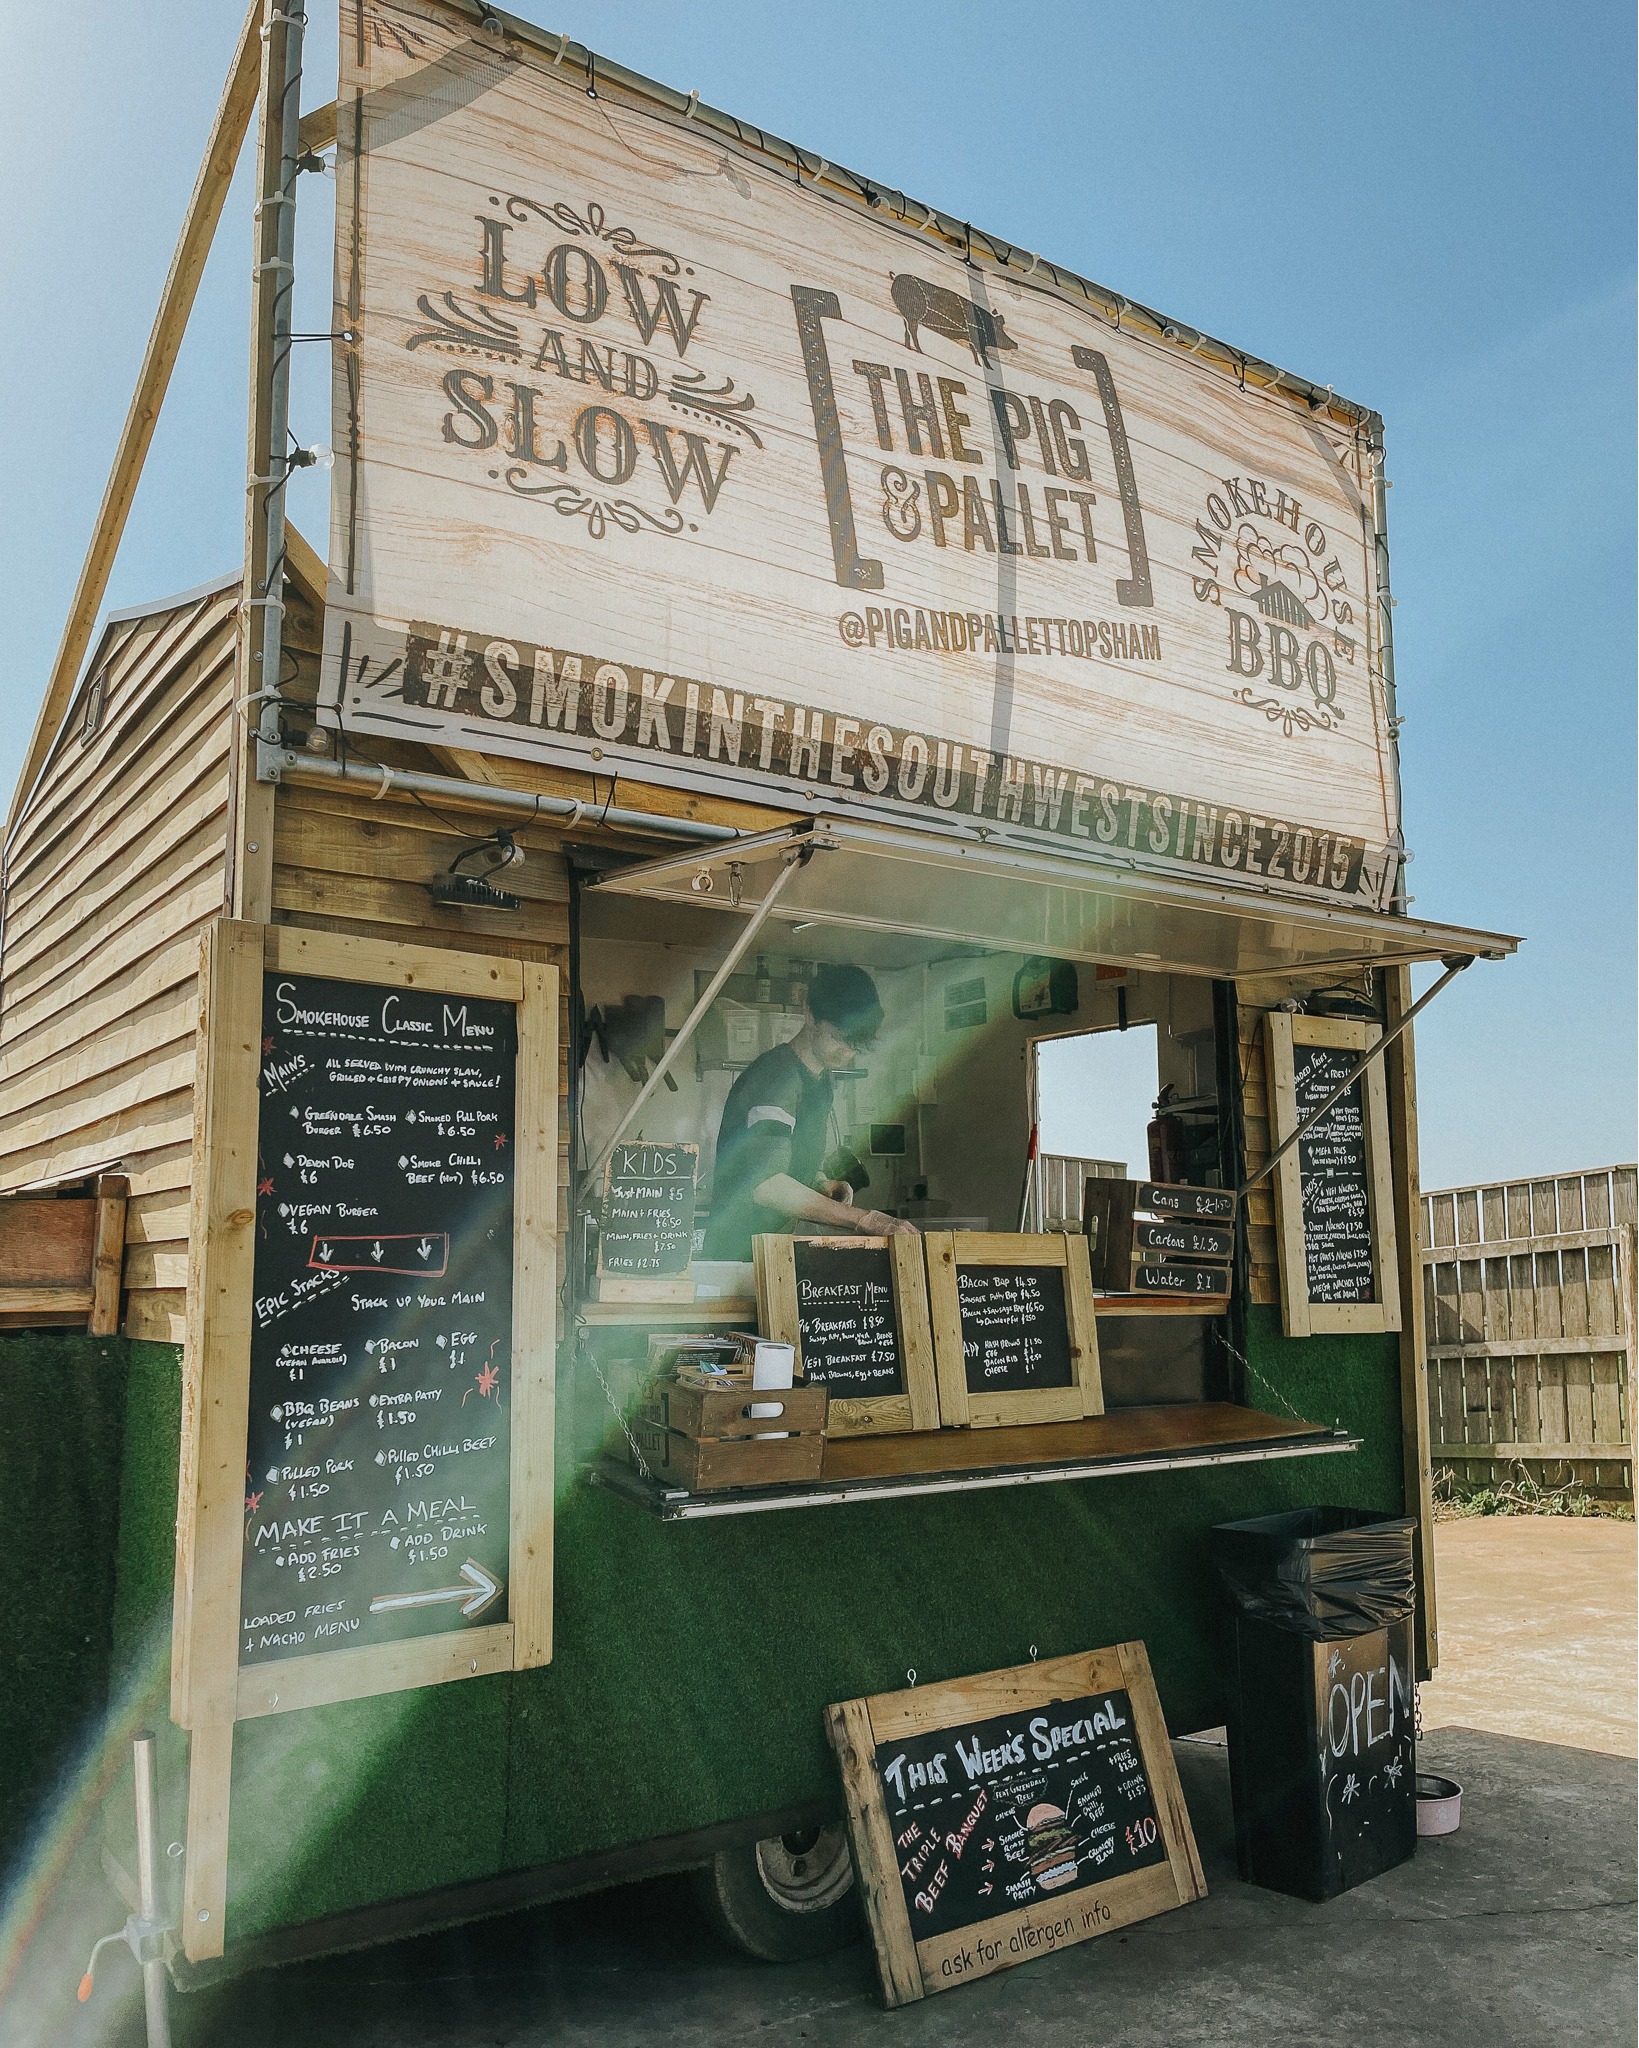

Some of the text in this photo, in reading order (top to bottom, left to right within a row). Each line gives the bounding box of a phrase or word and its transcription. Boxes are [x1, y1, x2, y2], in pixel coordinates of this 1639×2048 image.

[473, 215, 711, 358] LOW
[530, 328, 659, 401] AND
[852, 359, 1092, 481] THE PIG
[441, 369, 741, 515] SLOW
[1192, 477, 1355, 665] SMOKEHOUSE
[839, 606, 1162, 661] @PIGANDPALLETTOPSHAM
[1224, 607, 1345, 720] BBQ
[421, 631, 1352, 889] #SMOKINTHESOUTHWESTSINCE2015
[276, 982, 494, 1037] SMOKEHOUSE CLASSIC MENU
[263, 1054, 306, 1092] MAINS
[326, 1058, 482, 1078] ALL SERVED WITH CRUNCHY SLAW,
[329, 1071, 366, 1083] GRILLED
[376, 1073, 412, 1087] CRISPY
[412, 1077, 449, 1087] ONIONS
[304, 1105, 397, 1122] GREENDALE SMASH
[418, 1110, 498, 1123] SMOKED PULL PORK
[301, 1121, 342, 1135] BURGER
[297, 1154, 355, 1169] DEVON DOG
[410, 1154, 442, 1169] SMOKE
[622, 1150, 678, 1176] KIDS
[405, 1172, 436, 1184] BEEF
[288, 1203, 379, 1217] VEGAN BURGER
[1152, 1190, 1179, 1209] Cans
[611, 1208, 638, 1219] MAIN
[646, 1208, 671, 1218] FRIES
[660, 1231, 688, 1240] DRINK
[1148, 1228, 1185, 1249] Cartons
[608, 1257, 634, 1268] FRIES
[957, 1274, 989, 1288] BACON
[1145, 1268, 1186, 1287] Water
[351, 1291, 486, 1312] STACK UP YOUR MAIN
[796, 1279, 888, 1305] BREAKFAST MENU
[254, 1292, 289, 1319] EPIC
[291, 1343, 343, 1356] CHEESE
[379, 1338, 419, 1352] BACON
[451, 1332, 478, 1347] EGG
[282, 1397, 360, 1417] BBQ BEANS
[378, 1388, 443, 1407] EXTRA PATTY
[462, 1435, 498, 1452] BEEF
[280, 1458, 355, 1483] PULLED PORK
[254, 1495, 476, 1548] MAKE IT A MEAL
[404, 1523, 488, 1548] ADD DRINK
[287, 1545, 360, 1566] ADD FRIES
[244, 1600, 346, 1630] LOADED FRIES
[259, 1631, 306, 1649] NACHO
[314, 1617, 360, 1639] MENU
[1328, 1654, 1411, 1758] OPEN
[884, 1699, 1127, 1804] THIS WEEK'S SPECIAL
[897, 1820, 923, 1849] THE
[1125, 1816, 1157, 1856] £10
[901, 1826, 941, 1883] TRIPLE
[914, 1786, 989, 1914] BEEF BANQUET
[940, 1900, 1112, 1979] ask for allergen info
